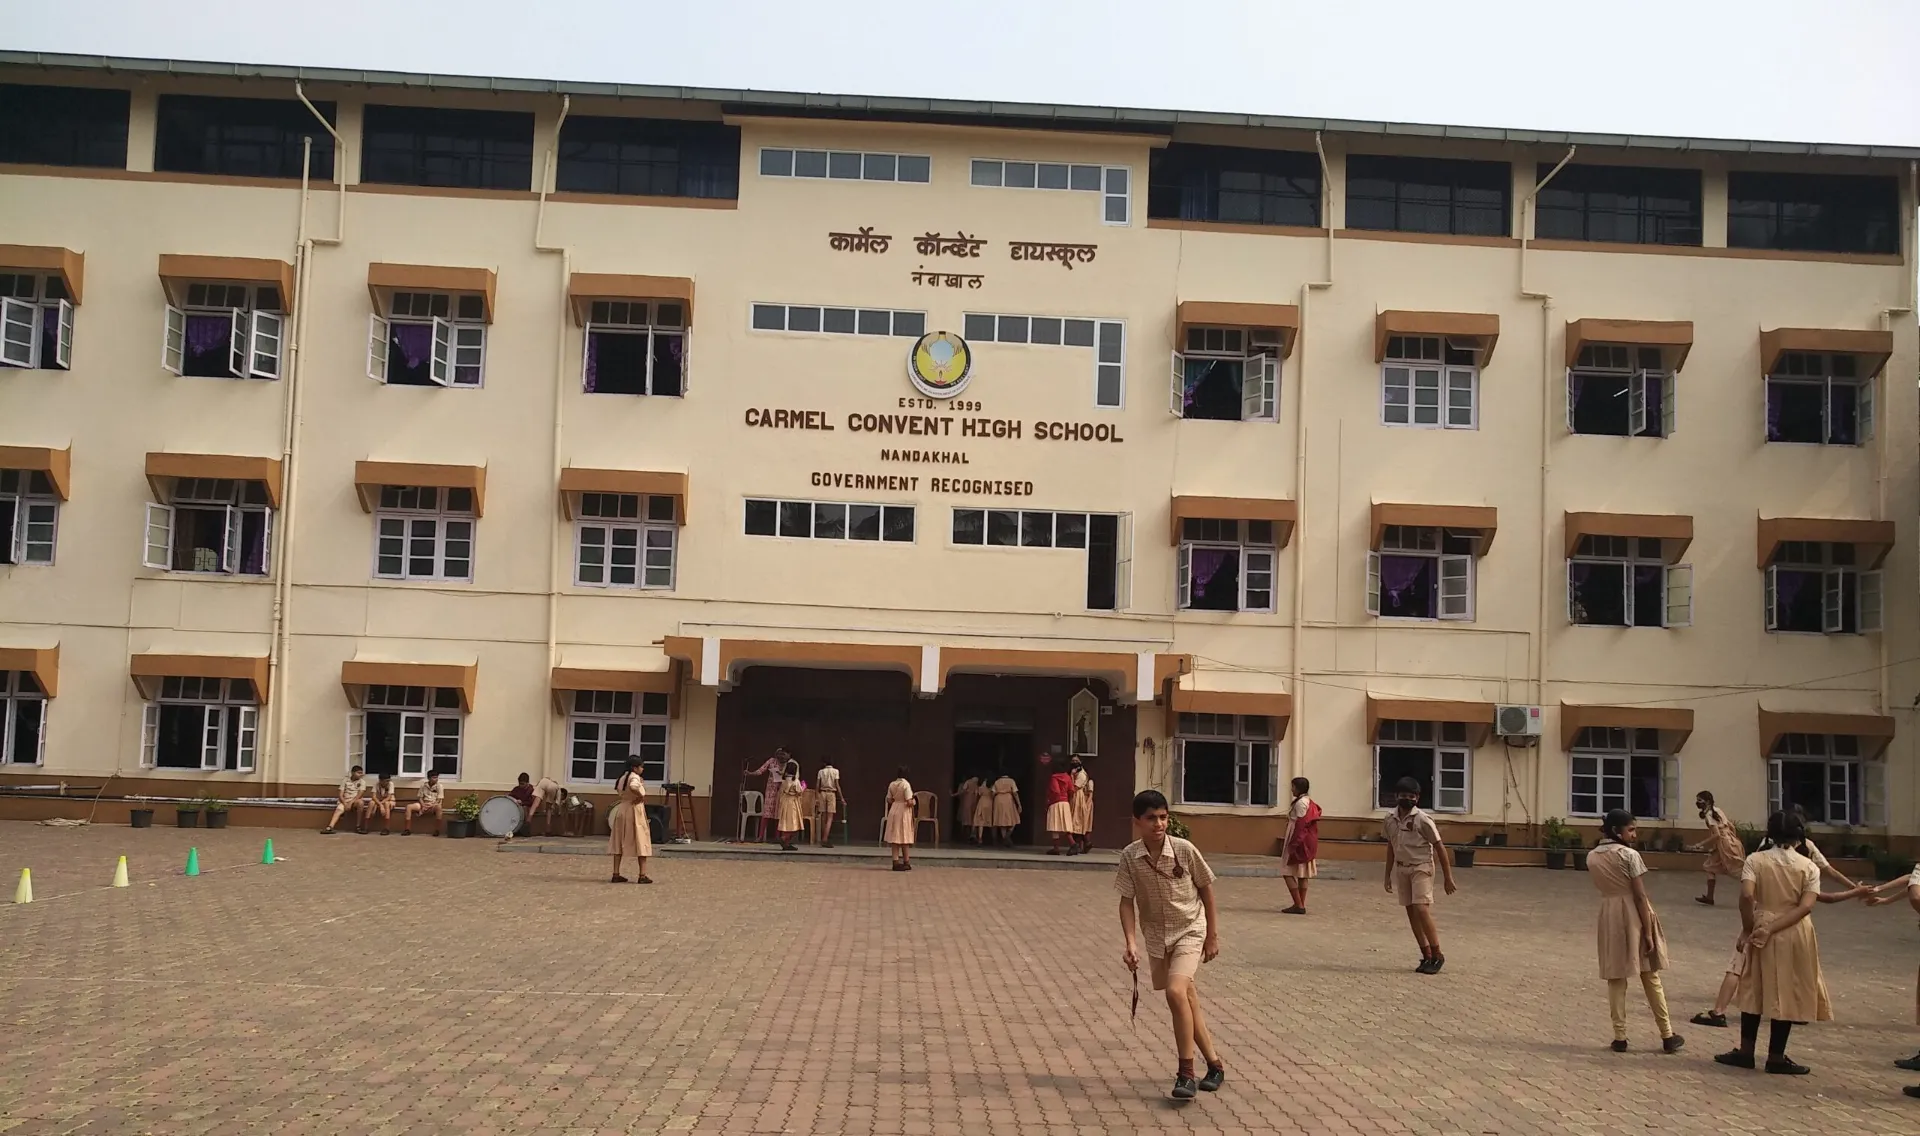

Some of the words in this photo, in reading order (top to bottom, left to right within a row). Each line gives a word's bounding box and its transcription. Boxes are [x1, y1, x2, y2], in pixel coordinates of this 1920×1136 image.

[829, 227, 892, 253] कार्मेल
[899, 397, 938, 410] ESTD.
[949, 399, 982, 411] 1999
[745, 408, 834, 430] CARMEL
[848, 413, 953, 435] CONVENT
[963, 418, 1021, 439] HIGH
[1035, 422, 1123, 442] SCHOOL
[881, 449, 969, 464] NANDAKHAL
[812, 472, 918, 491] GOVERNMENT
[932, 478, 1033, 495] RECOGNISED
